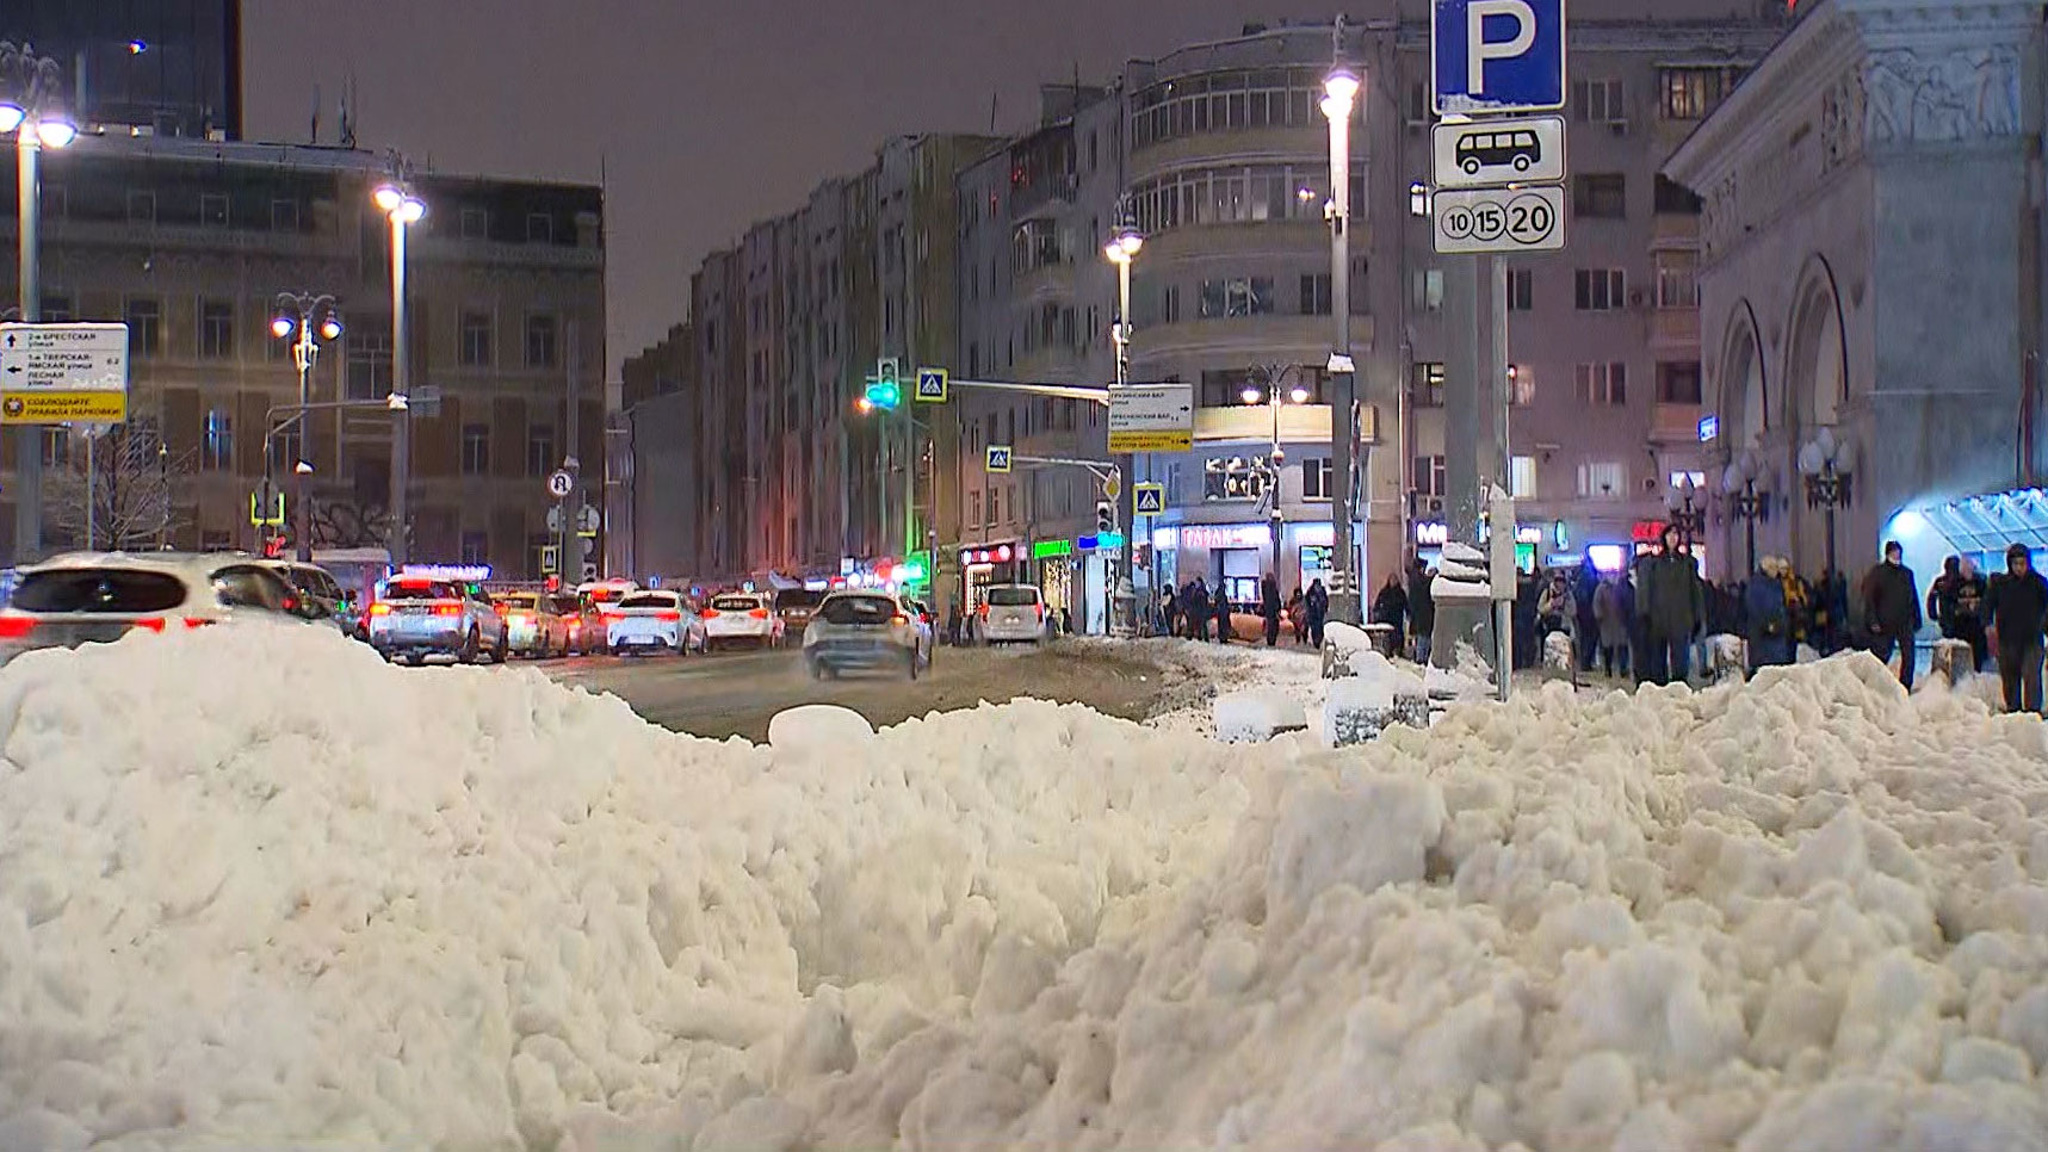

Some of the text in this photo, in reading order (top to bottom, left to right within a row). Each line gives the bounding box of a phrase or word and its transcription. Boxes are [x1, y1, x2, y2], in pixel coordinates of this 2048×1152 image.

[1467, 0, 1536, 95] P
[1449, 206, 1549, 233] 10 15 20
[43, 333, 96, 341] БРЕСТСКАЯ
[26, 408, 68, 416] ПРАВИЛА
